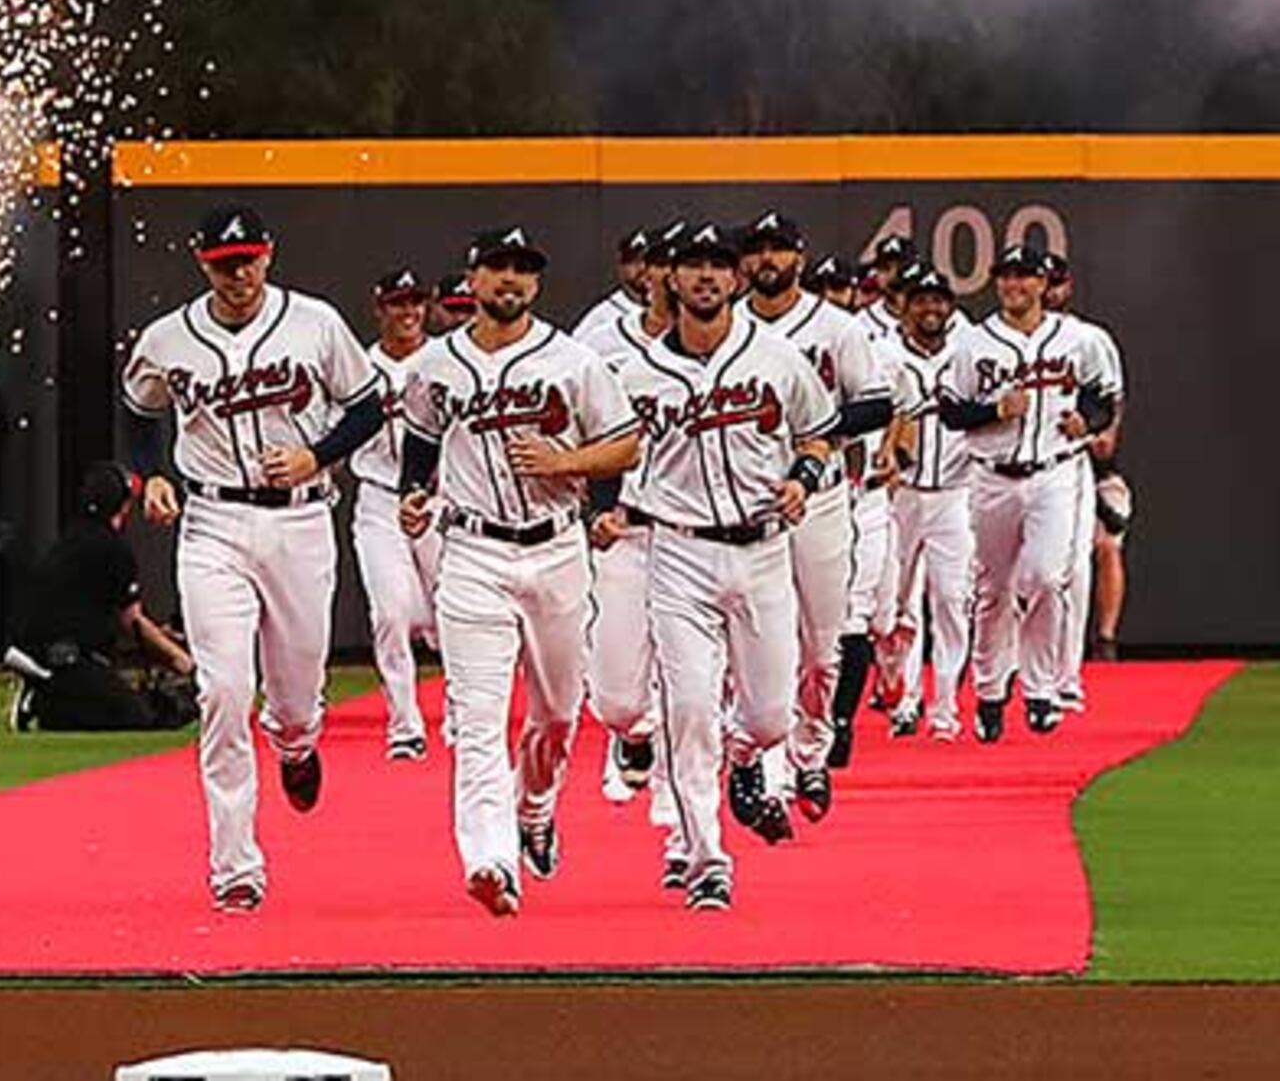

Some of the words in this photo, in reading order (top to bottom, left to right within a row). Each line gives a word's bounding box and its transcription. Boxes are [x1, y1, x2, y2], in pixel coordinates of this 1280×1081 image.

[222, 216, 245, 240] A
[503, 228, 526, 246] A
[693, 225, 718, 243] A
[169, 356, 291, 415] Braves
[429, 379, 544, 430] Braves
[630, 376, 758, 441] Braves
